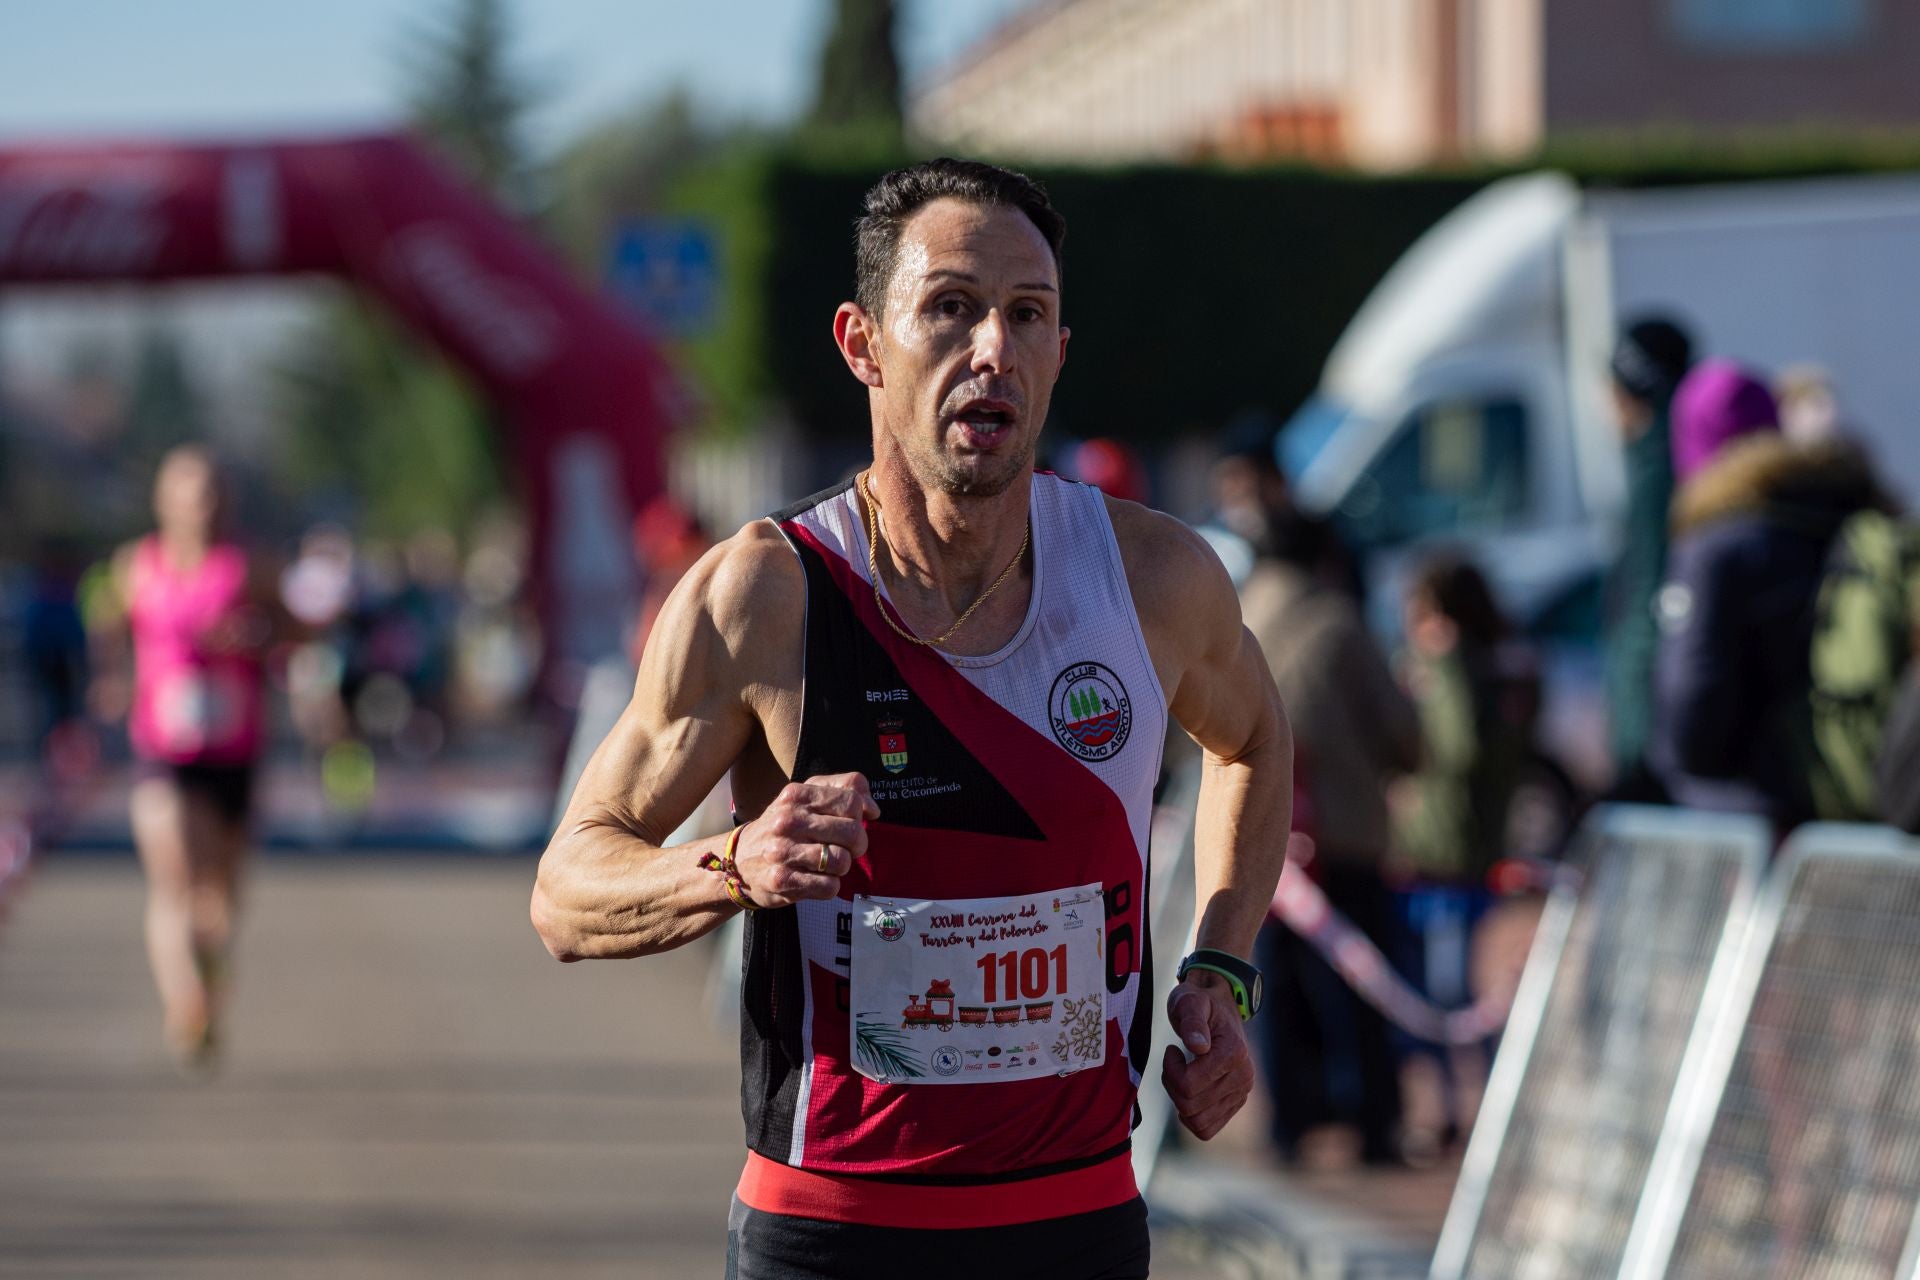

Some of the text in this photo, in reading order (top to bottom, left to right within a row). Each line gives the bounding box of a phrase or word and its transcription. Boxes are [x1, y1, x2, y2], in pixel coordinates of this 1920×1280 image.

[1064, 666, 1097, 684] CLUB
[1053, 698, 1129, 757] ATLETISMO ARROYO
[927, 776, 938, 785] de
[873, 789, 886, 800] de
[889, 789, 898, 800] la
[966, 935, 976, 949] y
[976, 943, 1068, 1004] 1101
